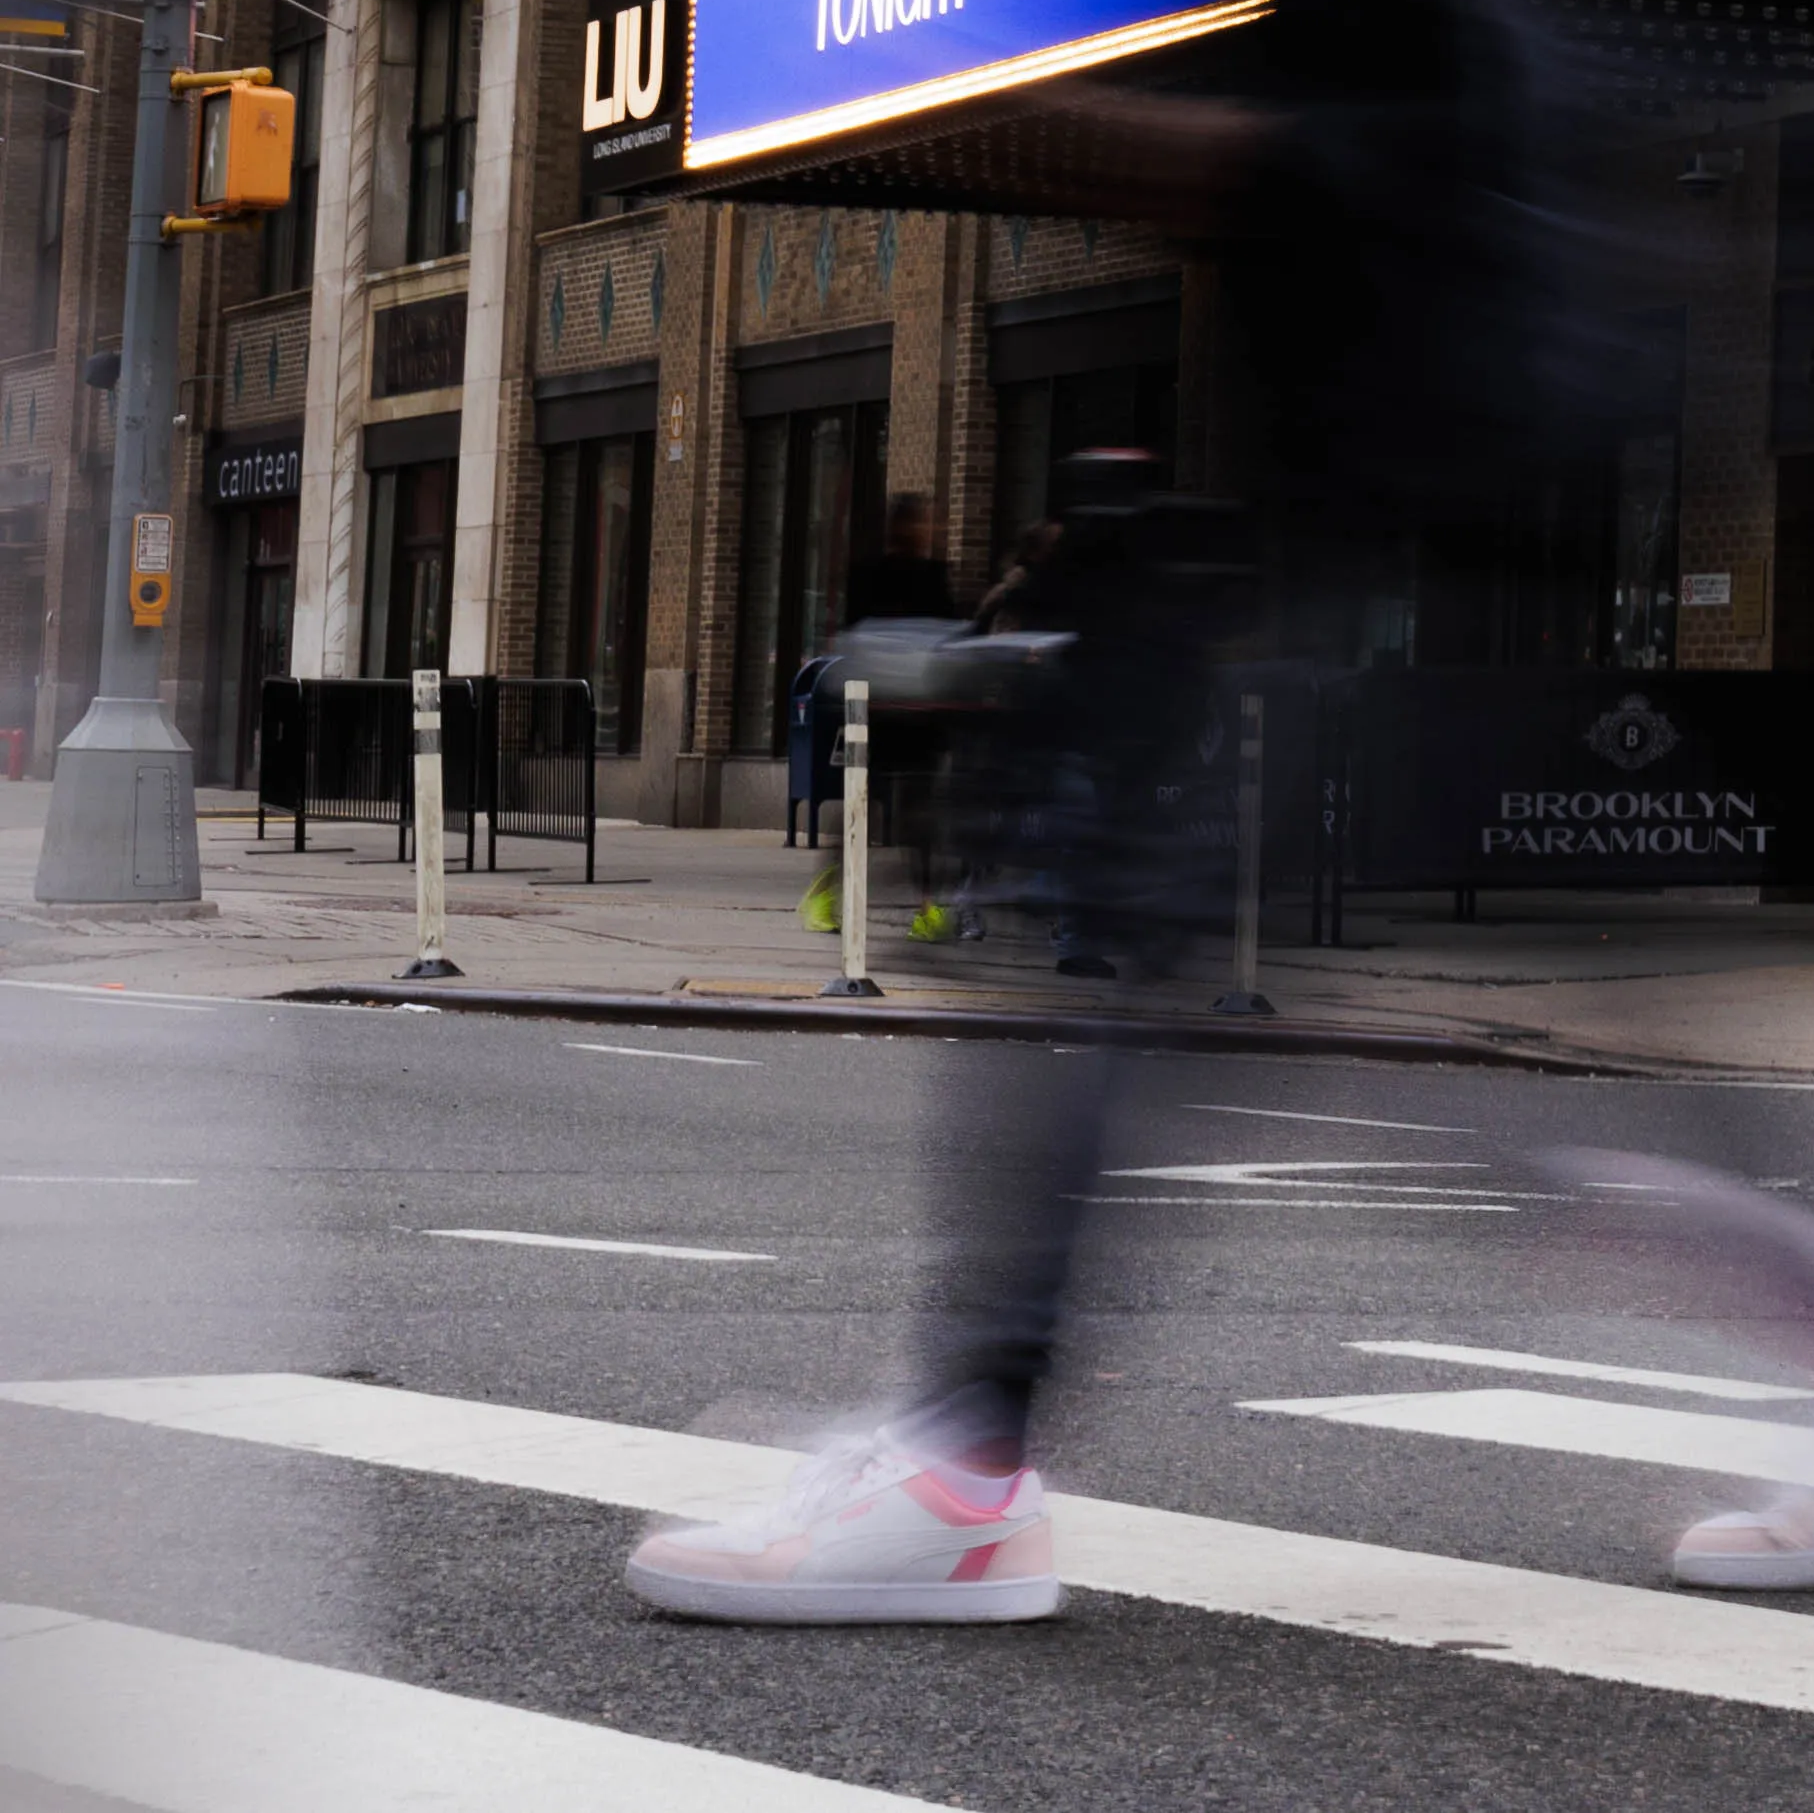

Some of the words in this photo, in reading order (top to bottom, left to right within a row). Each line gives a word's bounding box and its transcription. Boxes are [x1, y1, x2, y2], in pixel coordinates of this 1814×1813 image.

[219, 448, 298, 498] canteen
[1500, 789, 1757, 820] BROOKLYN
[1480, 825, 1777, 855] PARAMOUNT
